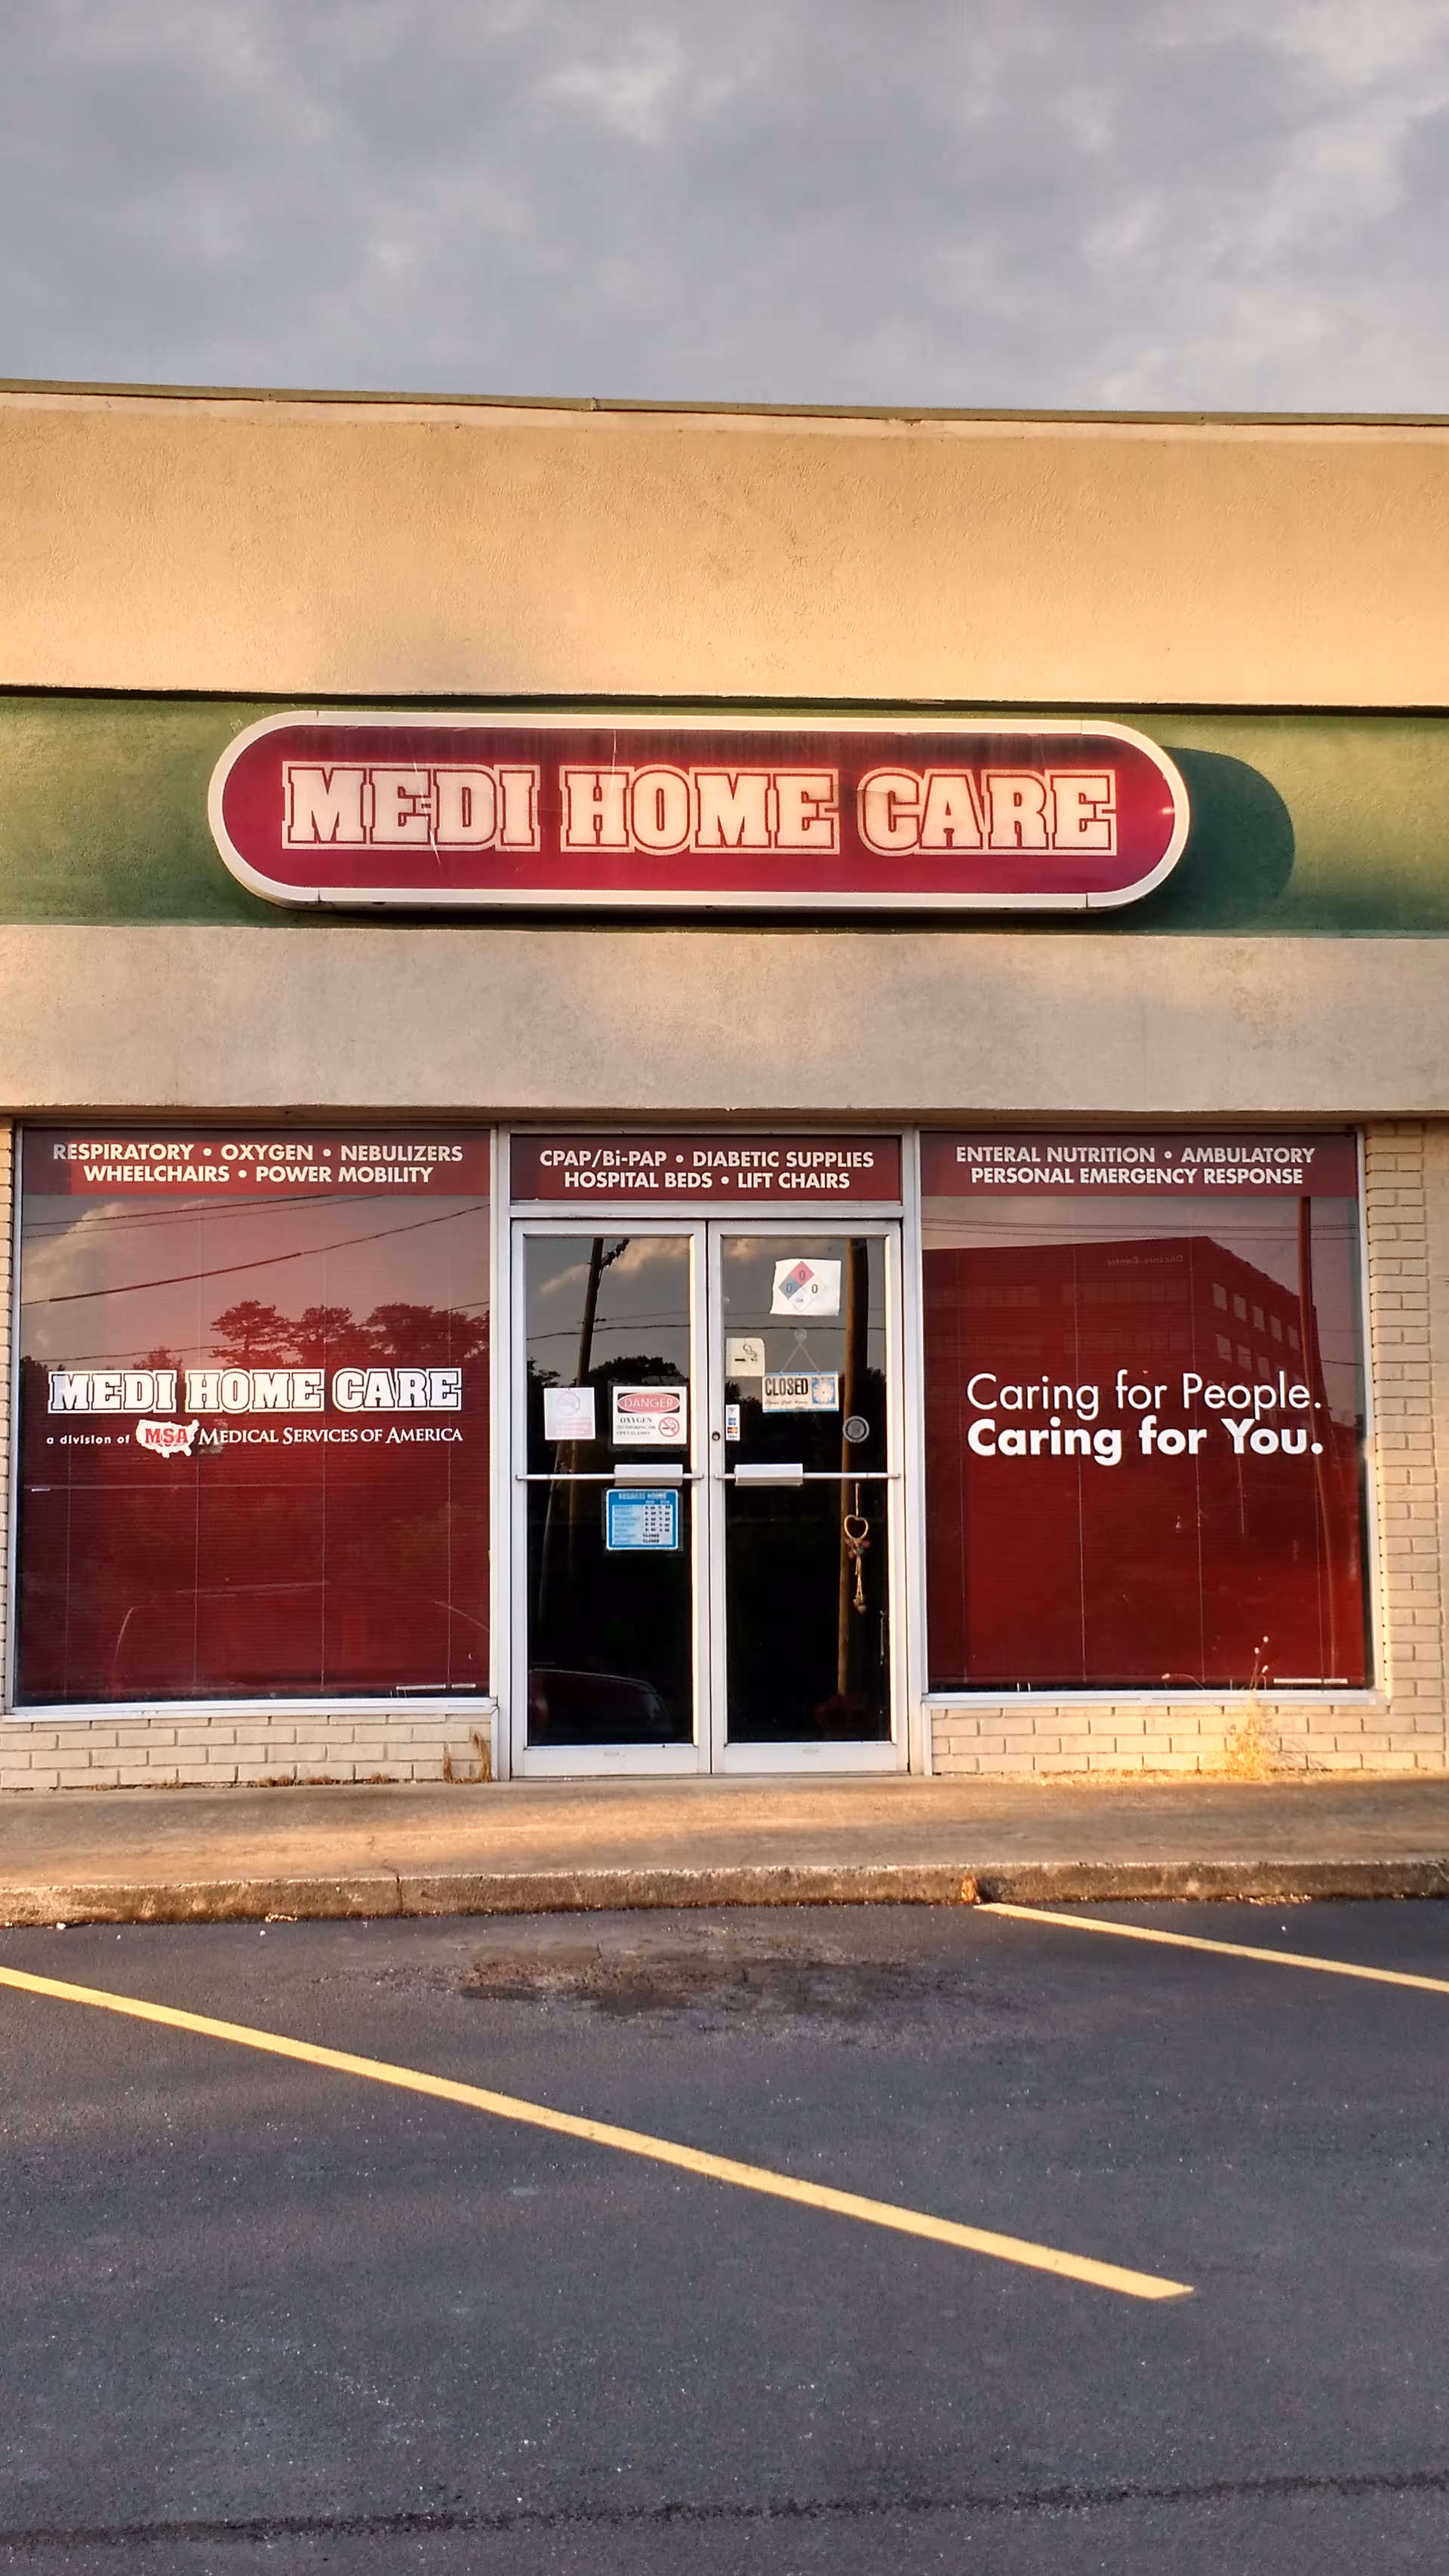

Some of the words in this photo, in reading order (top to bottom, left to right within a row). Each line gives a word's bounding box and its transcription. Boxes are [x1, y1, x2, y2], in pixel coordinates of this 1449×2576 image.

[281, 761, 541, 852] MEDI
[560, 764, 841, 855] HOME
[857, 766, 1118, 857] CARE
[54, 1143, 194, 1161] RESPIRATORY
[221, 1143, 314, 1161] OXYGEN
[340, 1145, 463, 1162] NEBULIZERS
[540, 1150, 667, 1168] CPAP/Bi-PAP
[693, 1150, 780, 1168] DIABETIC
[786, 1151, 874, 1168] SUPPLIES
[956, 1146, 1041, 1163] ENTERAL
[1047, 1146, 1155, 1163] NUTRITION
[1181, 1147, 1315, 1164] AMBULATORY
[84, 1165, 230, 1183] WHEELCHAIRS
[256, 1165, 332, 1183] POWER
[338, 1166, 434, 1183] MOBILITY
[565, 1171, 659, 1189] HOSPITAL
[665, 1171, 713, 1189] BEDS
[737, 1172, 772, 1190] LIFT
[779, 1172, 850, 1190] CHAIRS
[971, 1168, 1075, 1184] PERSONAL
[1080, 1168, 1198, 1184] EMERGENCY
[1204, 1168, 1303, 1185] RESPONSE
[799, 1270, 806, 1281] 0
[786, 1283, 792, 1293] 0
[811, 1284, 818, 1294] 0
[48, 1369, 178, 1414] MEDI
[184, 1368, 325, 1414] HOME
[332, 1367, 463, 1412] CARE
[764, 1377, 809, 1396] CLOSED
[967, 1373, 1100, 1420] Caring
[1116, 1369, 1168, 1410] for
[1183, 1371, 1322, 1422] People.
[624, 1398, 673, 1408] DANGER
[47, 1436, 54, 1445] a
[60, 1433, 113, 1445] division
[117, 1433, 131, 1445] of
[144, 1427, 189, 1445] MSA
[198, 1427, 279, 1445] MEDICAL
[282, 1426, 358, 1444] SERVICES
[386, 1426, 463, 1444] AMERICA
[968, 1417, 1122, 1465] Caring
[1139, 1414, 1208, 1455] for
[1220, 1417, 1324, 1456] You.
